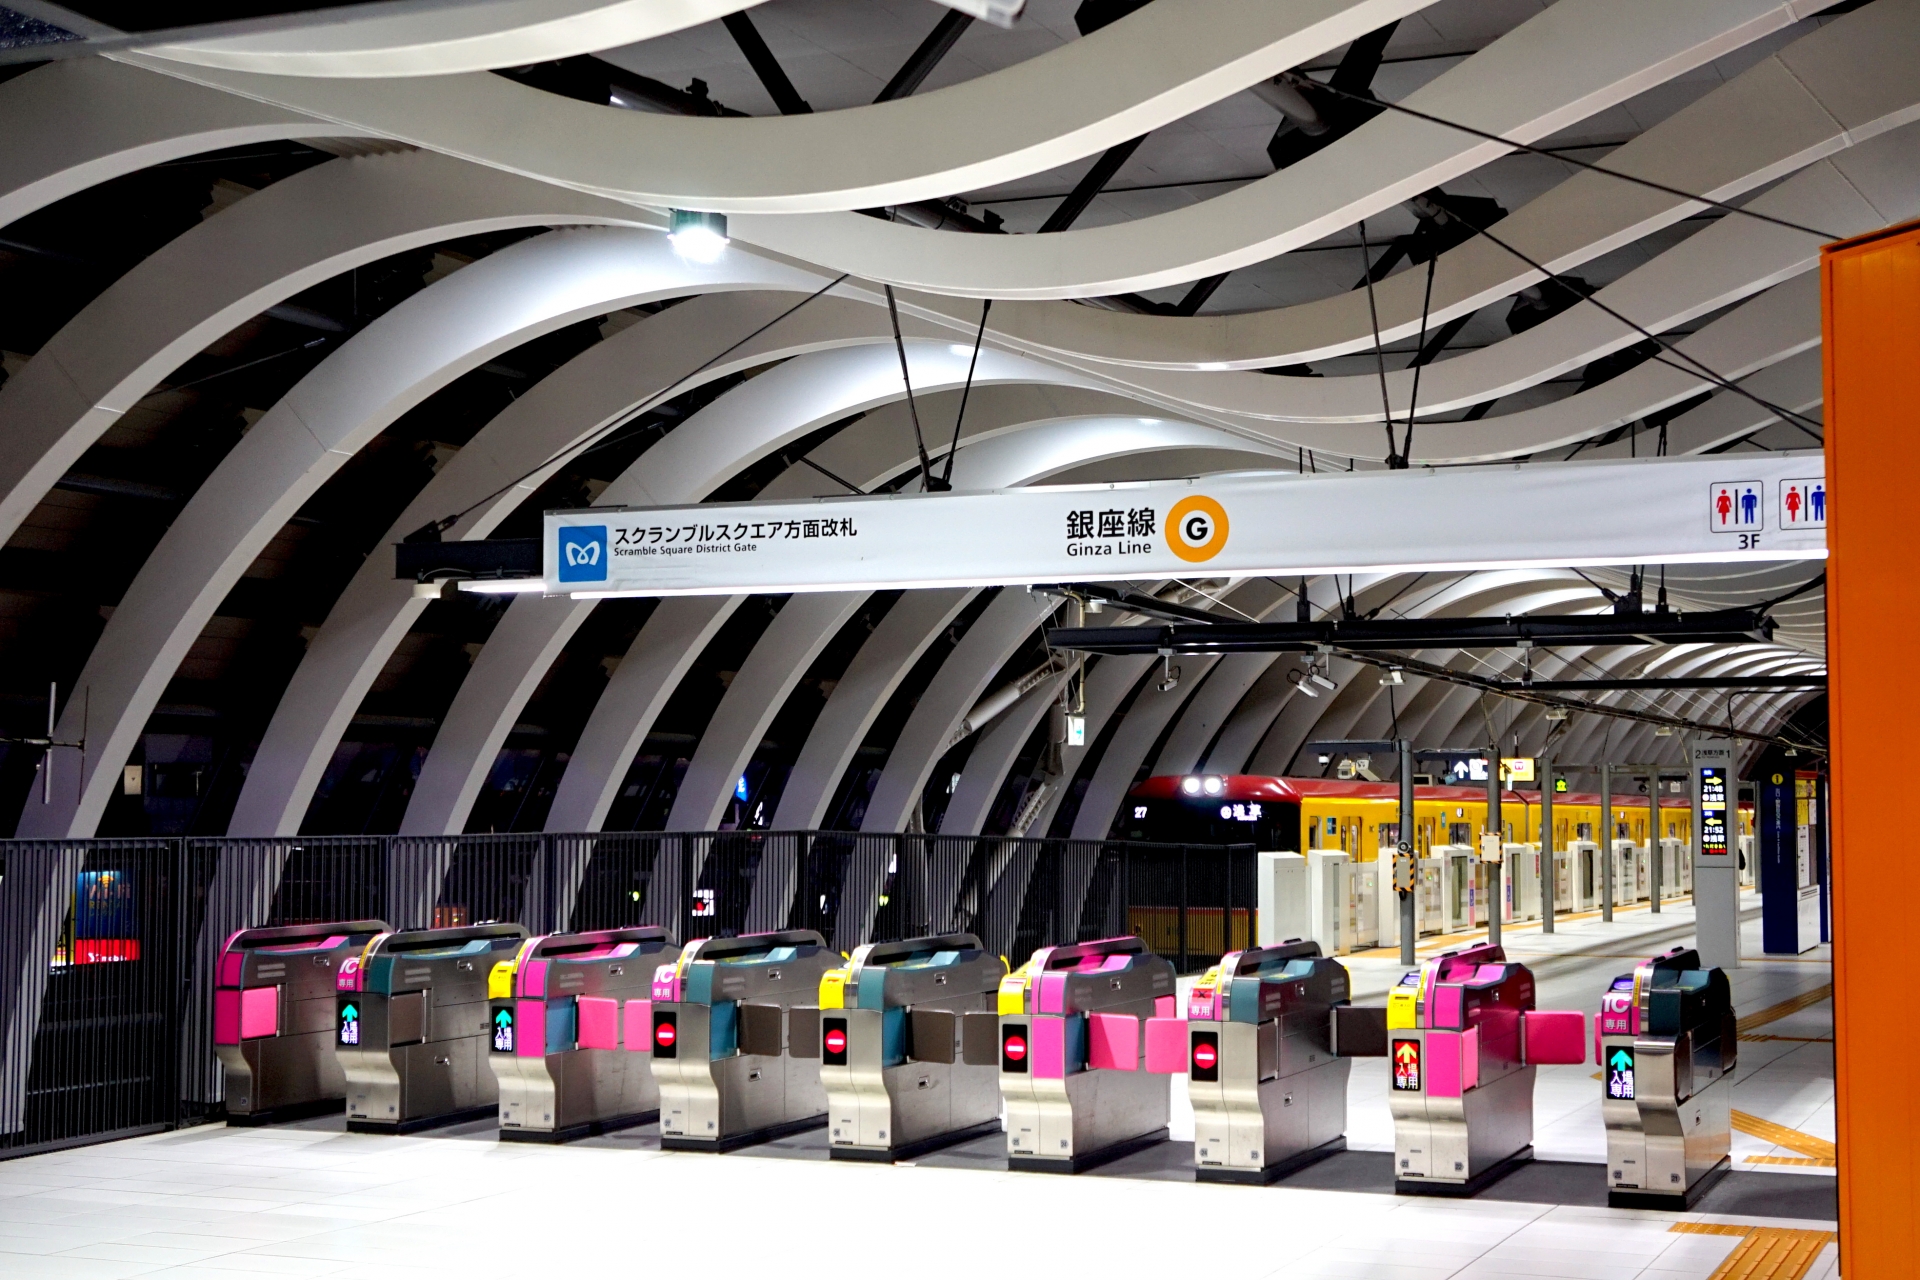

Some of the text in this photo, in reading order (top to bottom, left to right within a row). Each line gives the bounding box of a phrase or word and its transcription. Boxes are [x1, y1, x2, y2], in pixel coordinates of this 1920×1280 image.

[1066, 507, 1156, 540] 銀座線
[1186, 517, 1208, 541] G
[614, 517, 858, 546] スクランブルスクエア方面改札
[1066, 541, 1152, 557] Ginza Line
[1738, 534, 1760, 549] 3F
[614, 542, 757, 557] Scramble Square District Gate
[1695, 750, 1701, 759] 2
[1726, 750, 1731, 759] 1
[1134, 806, 1148, 819] 27
[339, 957, 360, 974] IC
[339, 978, 354, 988] 専用
[654, 988, 670, 998] 専用
[1191, 1005, 1210, 1016] 専用
[1603, 993, 1631, 1014] IC
[1605, 1019, 1627, 1030] 専用
[1610, 1070, 1634, 1085] 入場
[1610, 1084, 1634, 1098] 専用
